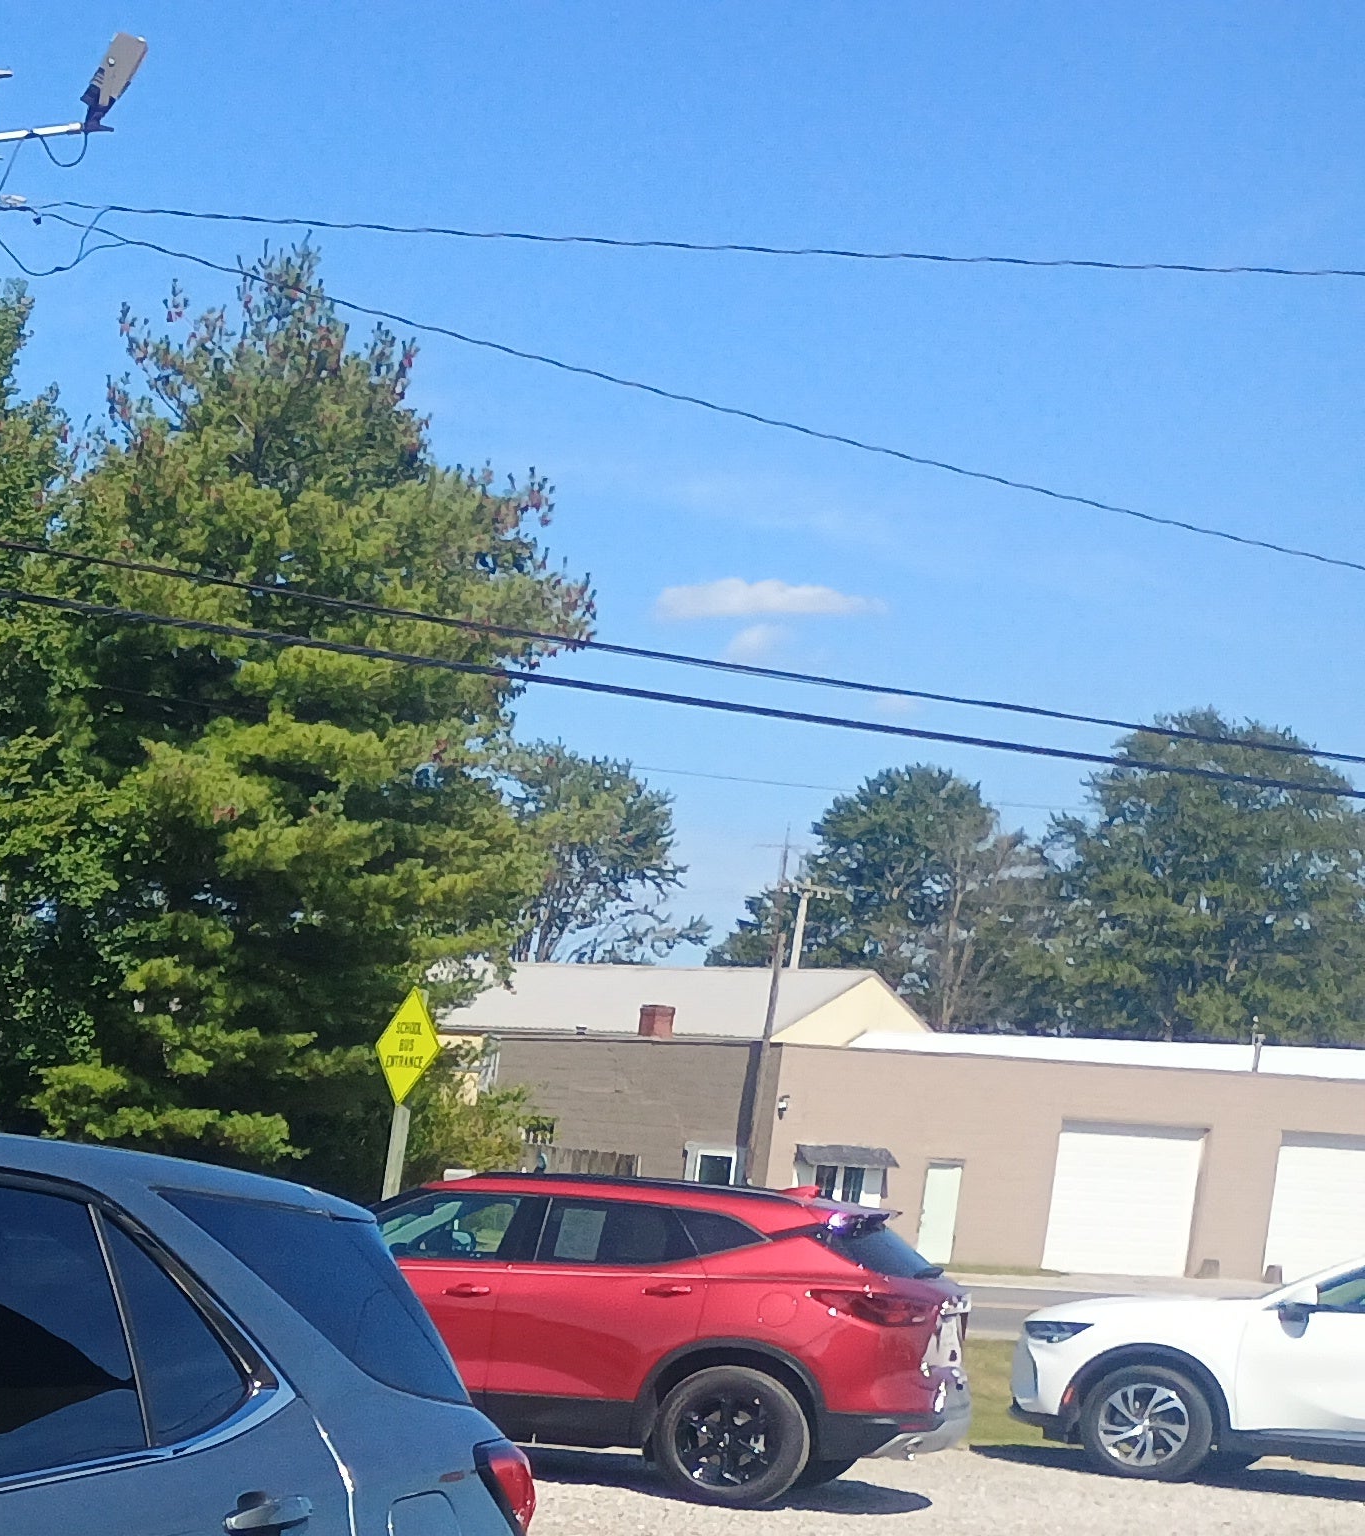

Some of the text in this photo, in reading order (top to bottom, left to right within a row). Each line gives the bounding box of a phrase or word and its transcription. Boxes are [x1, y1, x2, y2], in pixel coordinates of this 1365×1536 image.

[396, 1021, 423, 1036] SCHOOL
[398, 1038, 415, 1052] BUS
[385, 1055, 424, 1069] ENTRANCE
